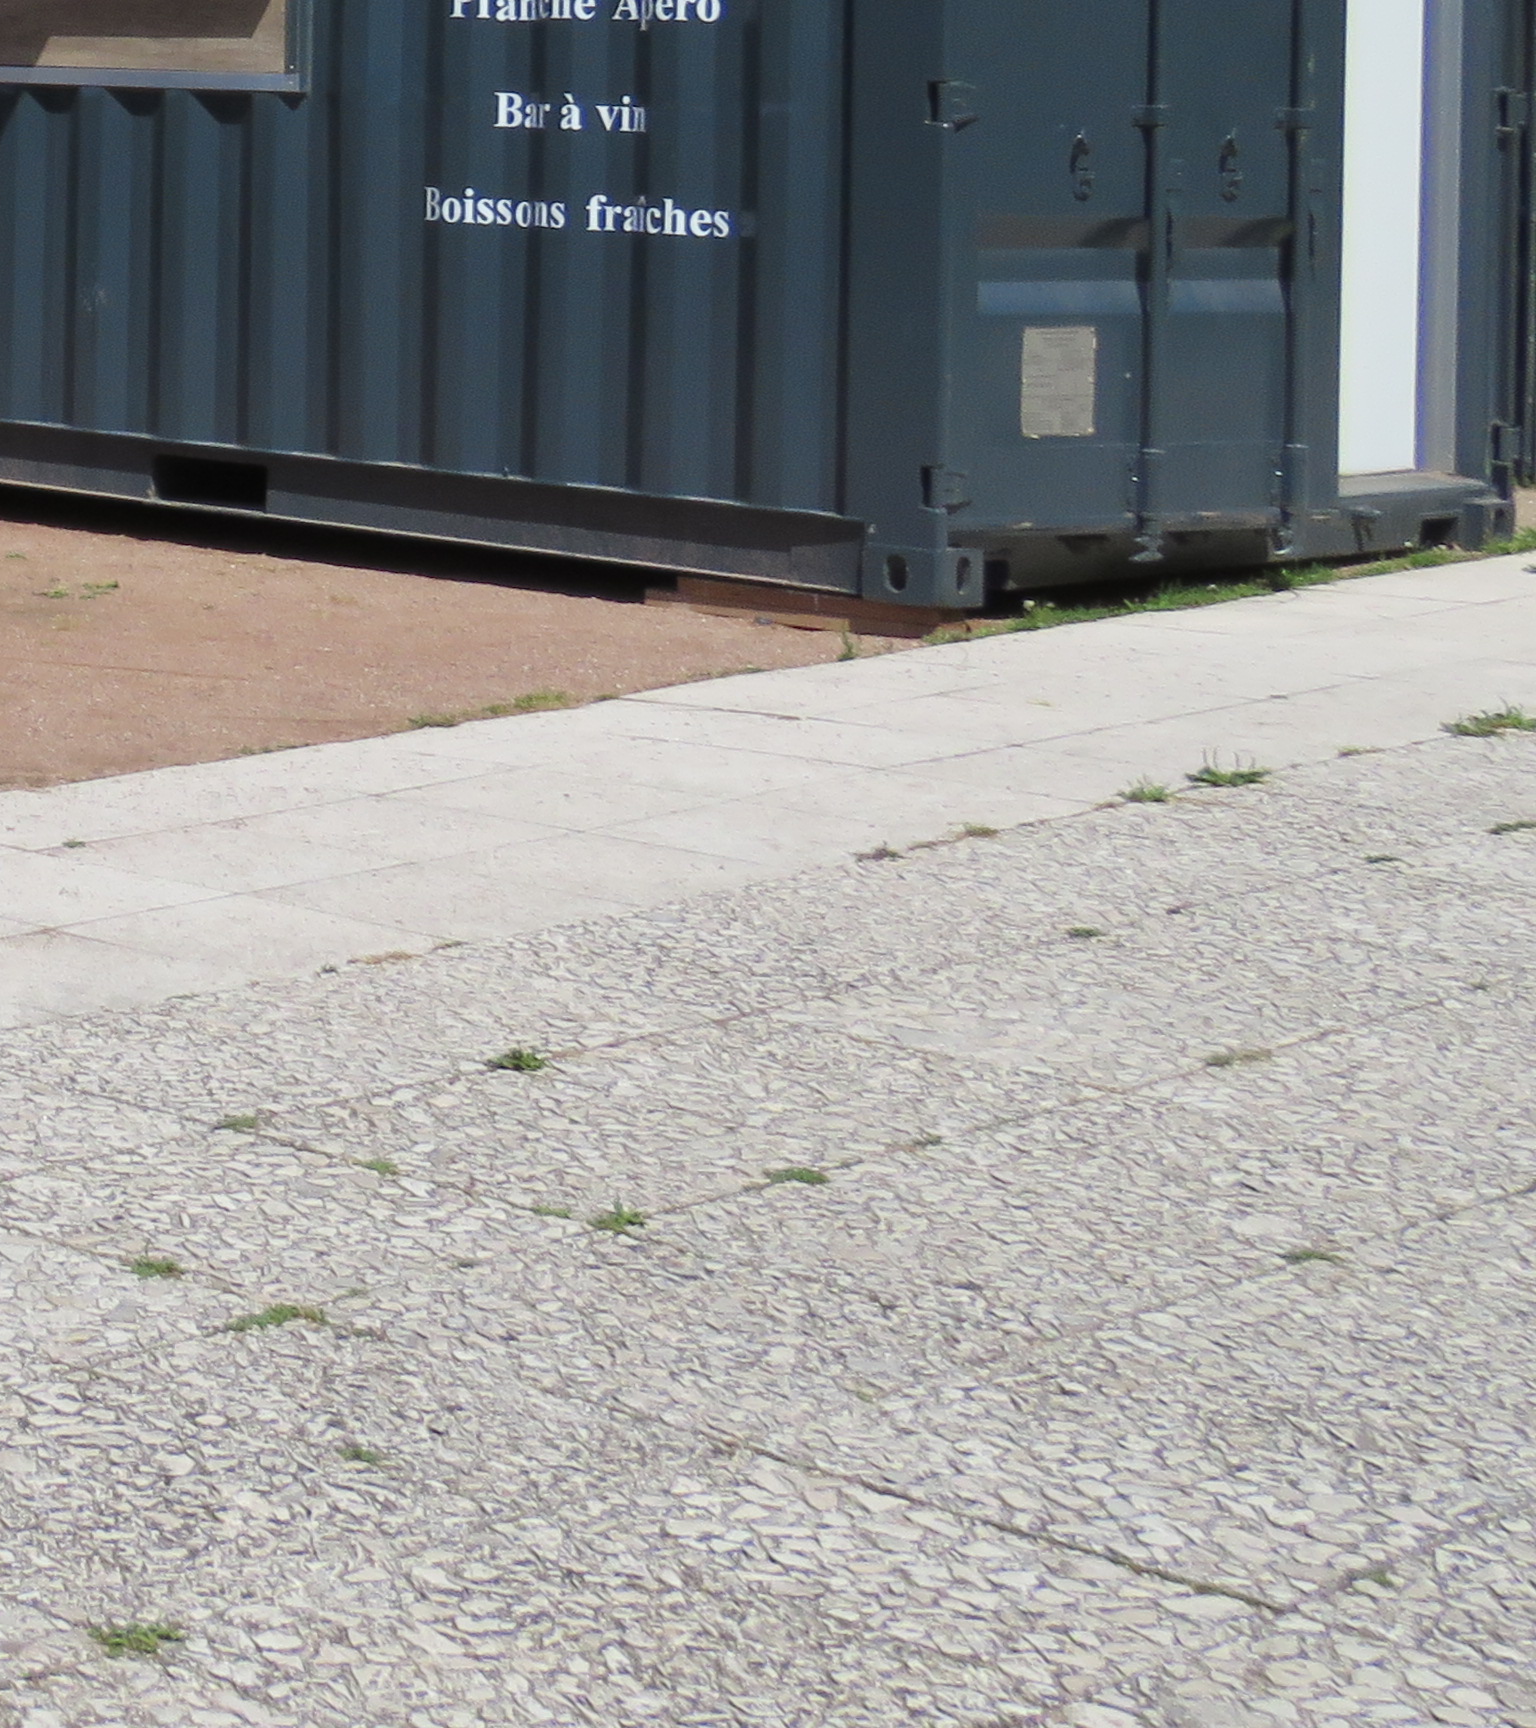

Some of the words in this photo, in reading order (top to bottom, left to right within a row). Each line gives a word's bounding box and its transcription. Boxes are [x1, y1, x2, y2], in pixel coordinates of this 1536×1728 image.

[493, 92, 551, 129] Bar
[559, 93, 583, 130] à
[596, 96, 647, 132] vin
[424, 186, 566, 229] Boissons
[585, 194, 730, 239] fraîches
